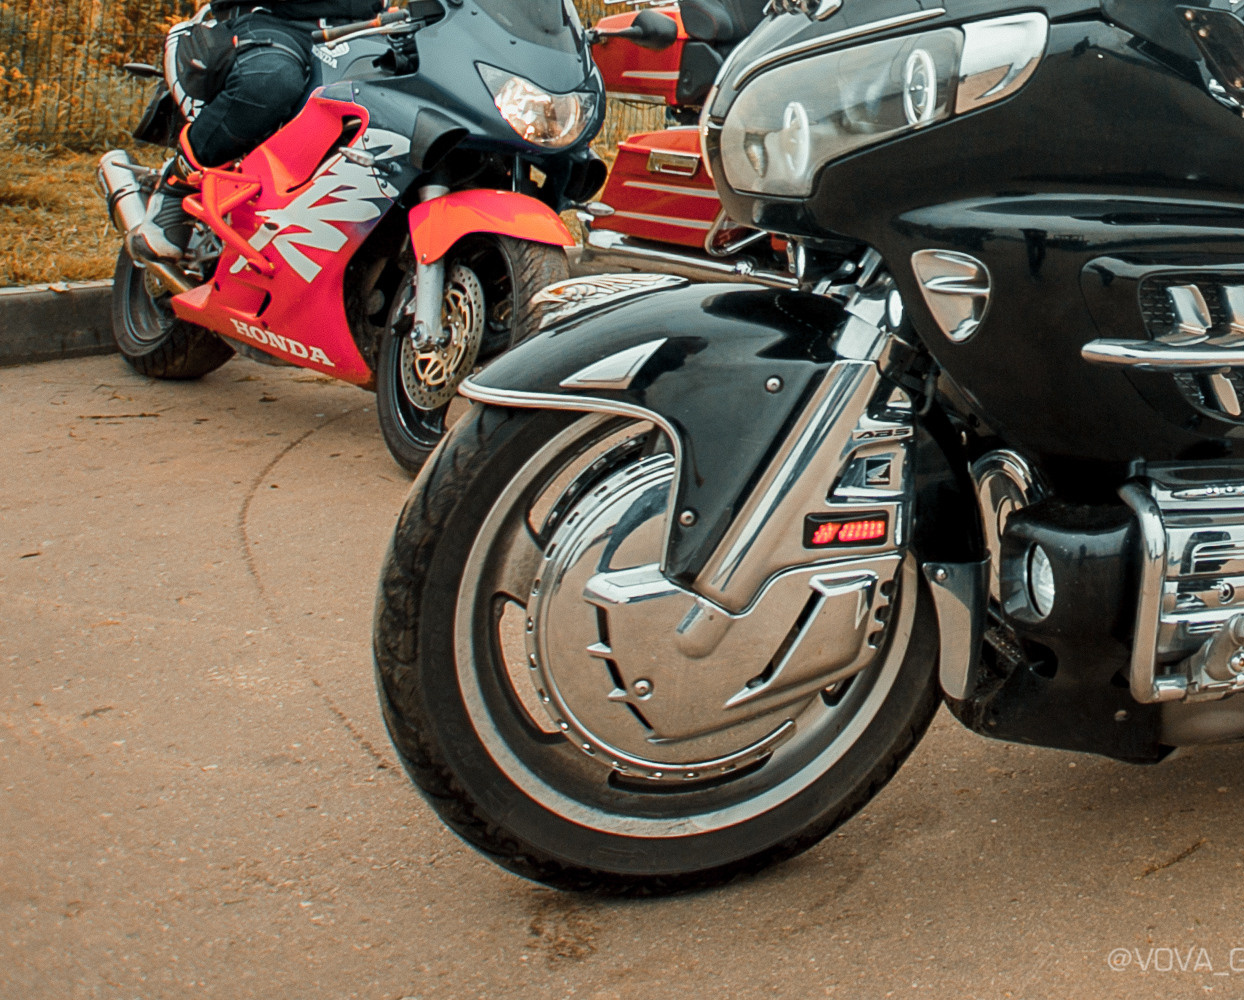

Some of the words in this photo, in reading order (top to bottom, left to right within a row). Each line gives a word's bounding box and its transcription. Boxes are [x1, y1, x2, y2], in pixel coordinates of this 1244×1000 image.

[311, 43, 338, 69] ONDA
[229, 317, 336, 368] HONDA
[856, 428, 911, 440] ABS
